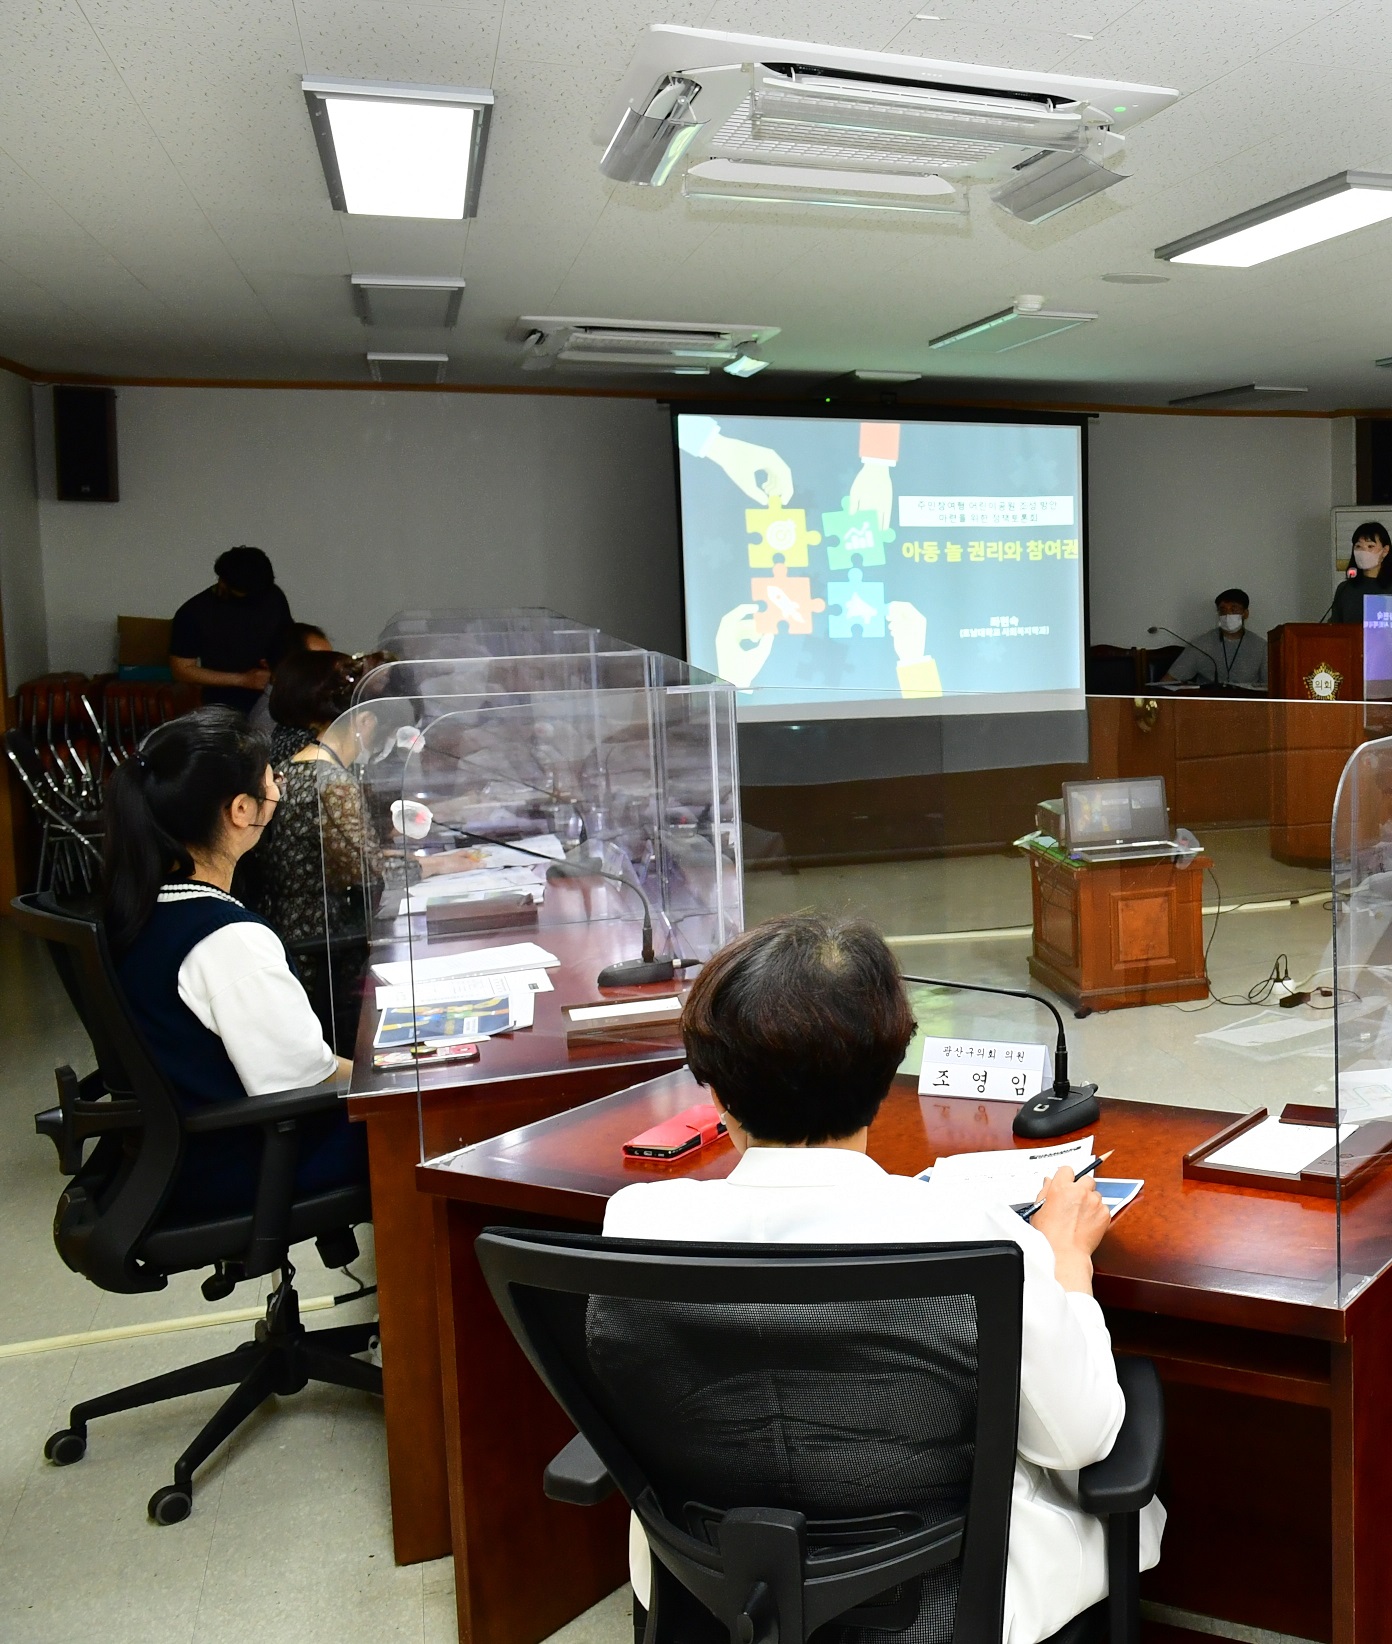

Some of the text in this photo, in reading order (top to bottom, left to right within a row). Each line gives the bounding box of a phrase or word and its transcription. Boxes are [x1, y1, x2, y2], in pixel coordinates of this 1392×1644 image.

[969, 500, 1016, 511] 어린이공원
[970, 513, 988, 523] 위한
[901, 539, 1079, 563] 아동 놀 권리와 참여권
[1314, 679, 1332, 691] 의회
[942, 1045, 1025, 1062] 광산구의회 의원
